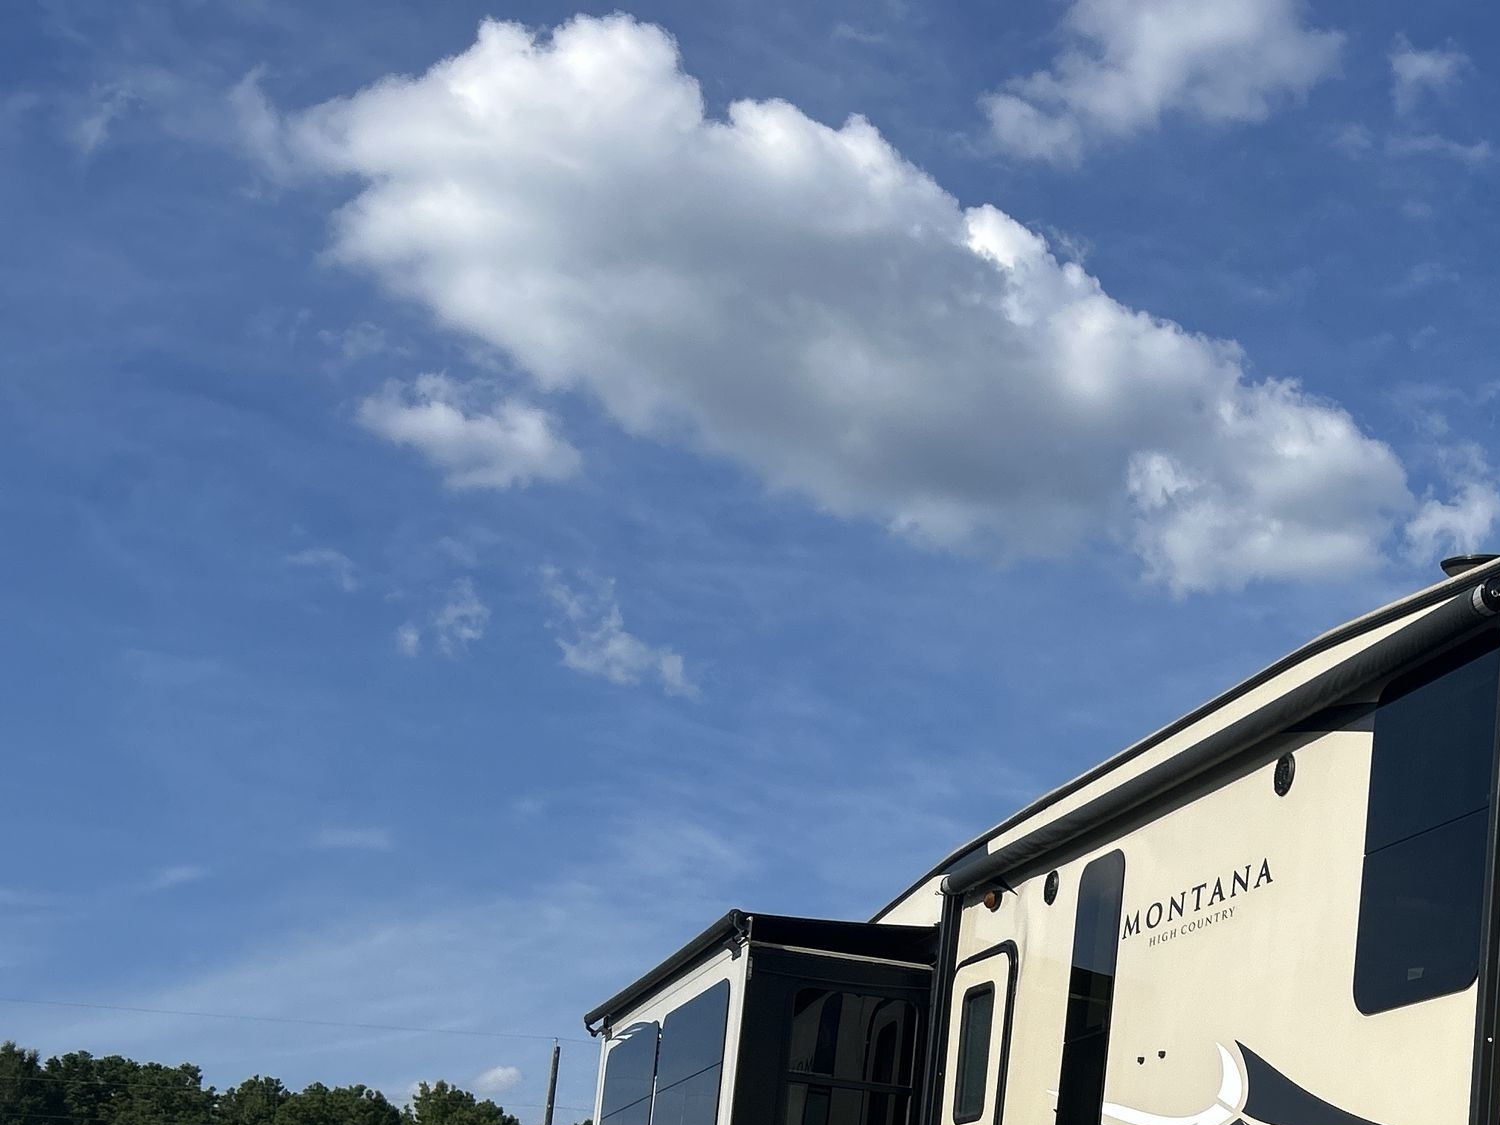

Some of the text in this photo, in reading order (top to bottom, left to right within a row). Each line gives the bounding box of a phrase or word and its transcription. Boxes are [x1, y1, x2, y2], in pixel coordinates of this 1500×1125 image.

[1121, 857, 1274, 940] MONTANA
[1149, 906, 1236, 948] HIGH COUNTRY
